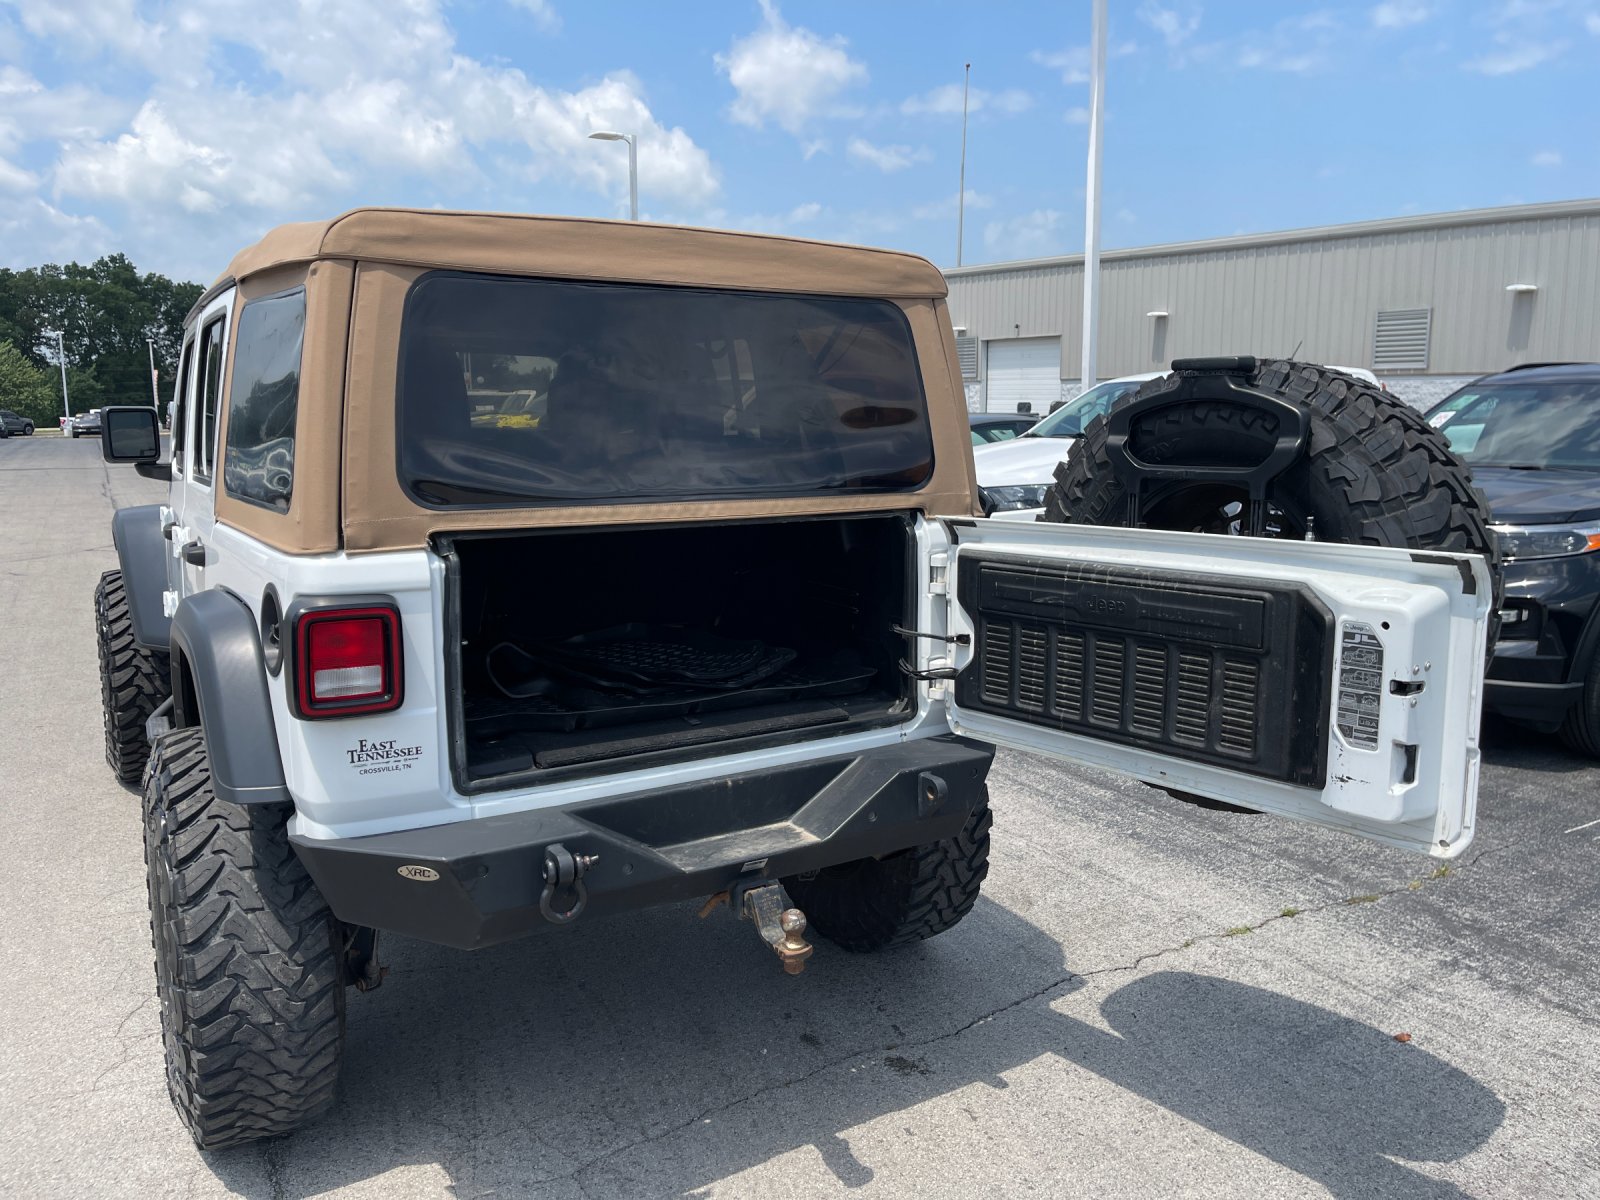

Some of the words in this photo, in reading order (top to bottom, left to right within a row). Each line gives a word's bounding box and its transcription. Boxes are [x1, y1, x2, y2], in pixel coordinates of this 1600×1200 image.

[1088, 594, 1127, 614] Jeep
[1344, 633, 1378, 644] JL
[1360, 719, 1377, 728] USA
[358, 739, 396, 753] EAST
[347, 746, 423, 764] TENNESSEE
[359, 764, 401, 775] CROSSVILLE,
[405, 867, 431, 878] XRC
